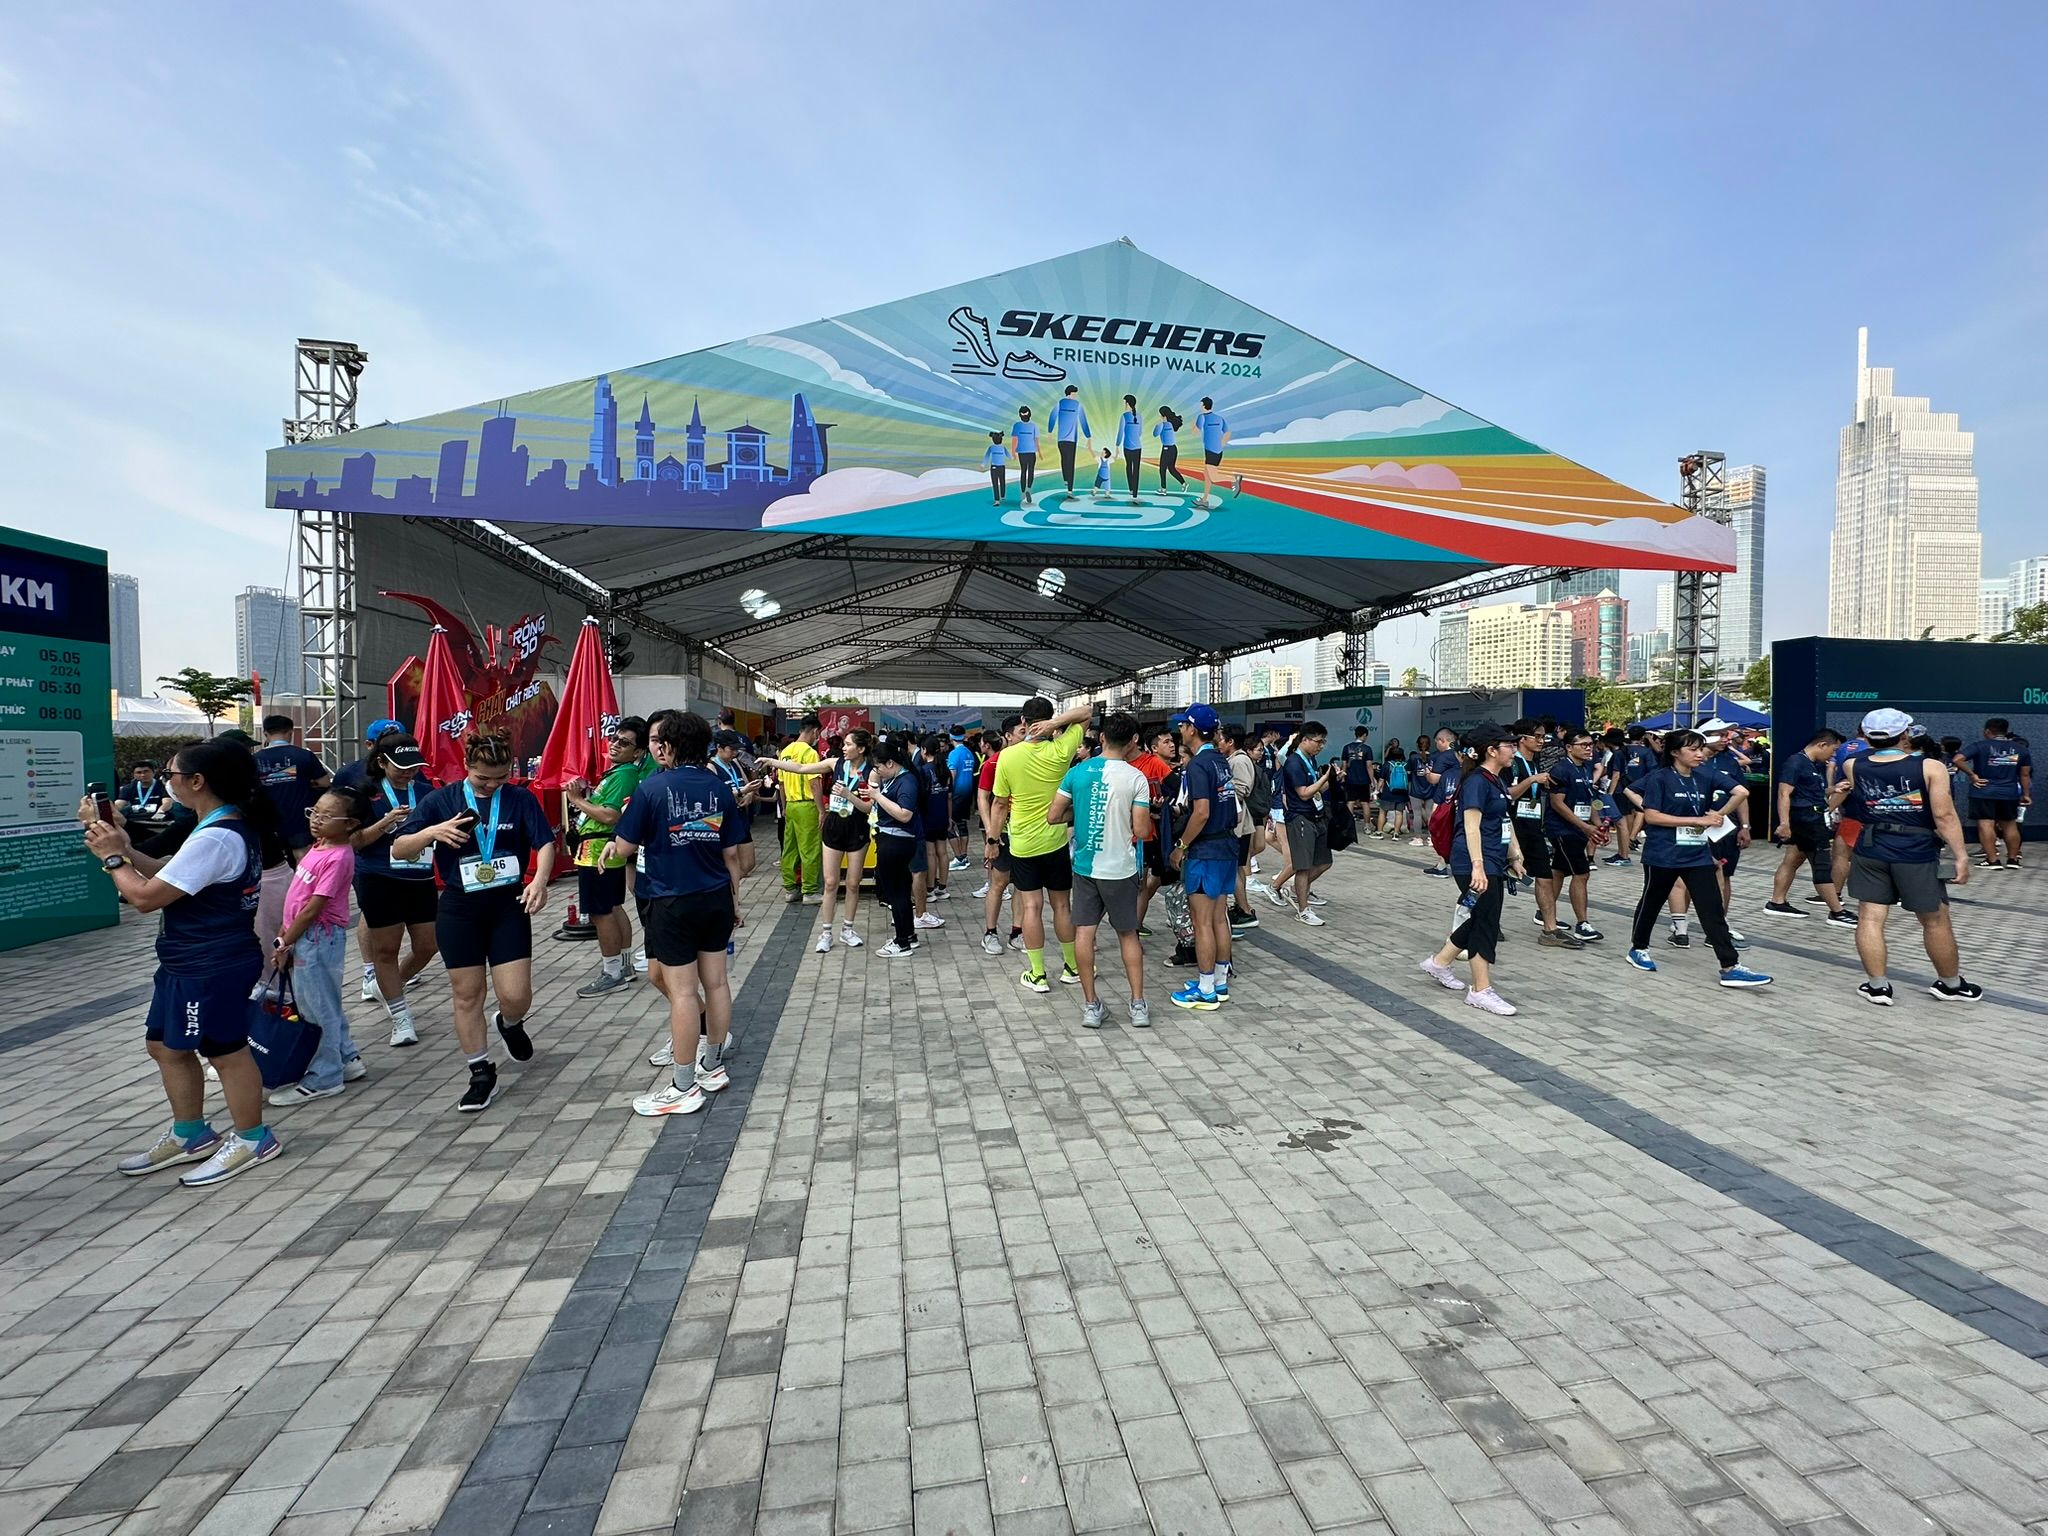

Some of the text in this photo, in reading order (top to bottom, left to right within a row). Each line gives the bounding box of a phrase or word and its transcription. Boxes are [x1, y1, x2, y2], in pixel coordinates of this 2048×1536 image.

[996, 309, 1266, 358] SKECHERS
[1053, 347, 1262, 378] FRIENDSHIP WALK 2024
[40, 648, 80, 664] 05.05
[50, 664, 80, 677] 2024
[6, 677, 35, 688] PHÁT
[39, 681, 80, 695] 05:30
[1826, 691, 1879, 699] SKECHERS
[39, 706, 81, 720] 08:00
[1088, 781, 1099, 829] MARATHON
[1094, 783, 1110, 852] FINISHER
